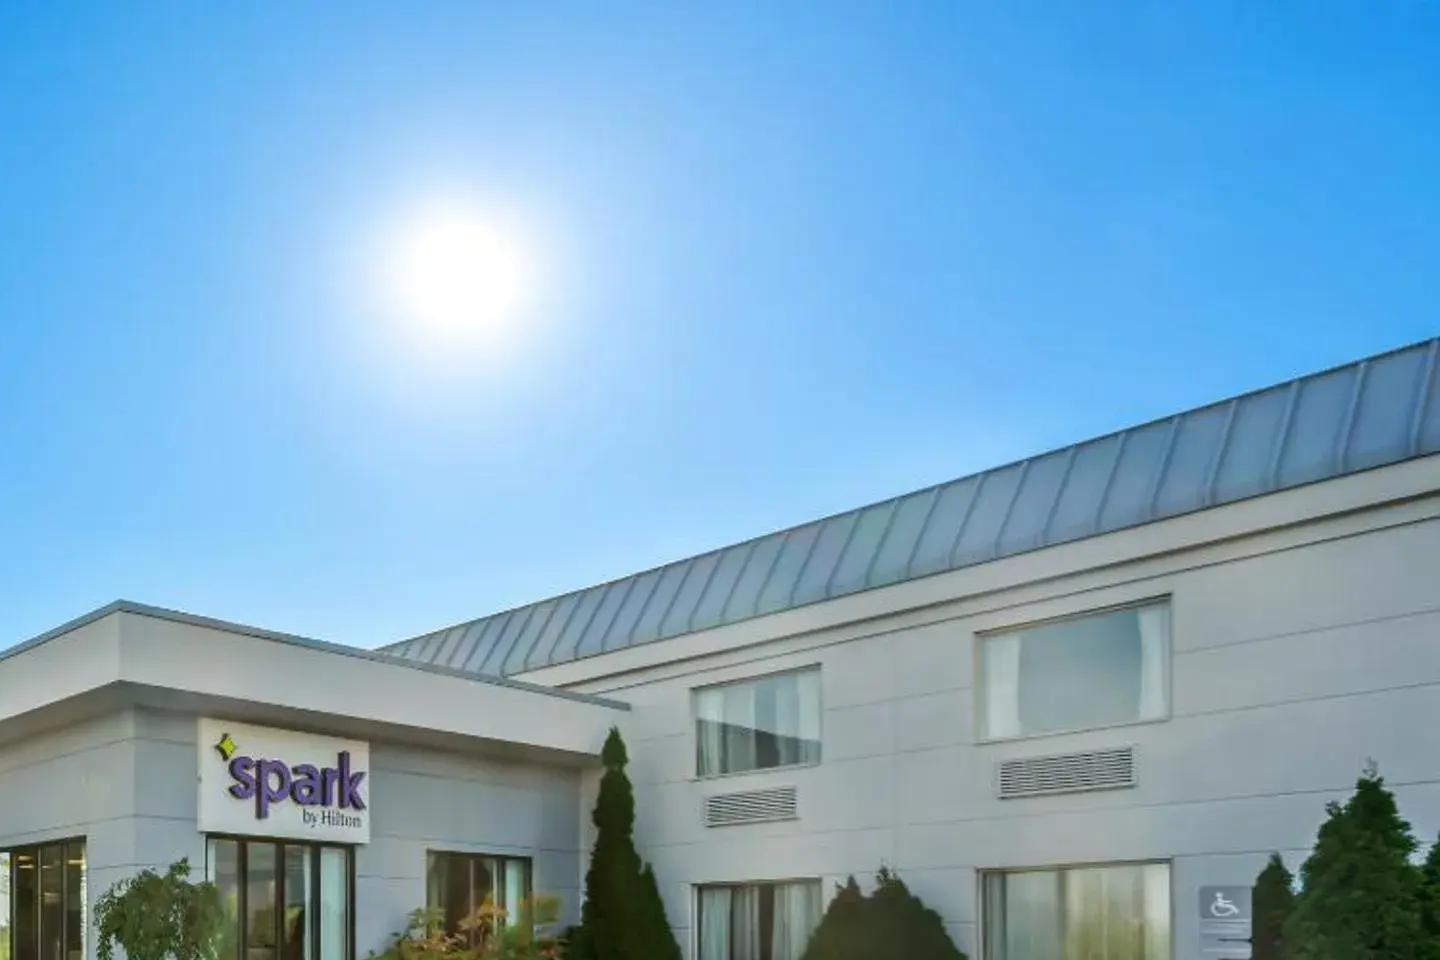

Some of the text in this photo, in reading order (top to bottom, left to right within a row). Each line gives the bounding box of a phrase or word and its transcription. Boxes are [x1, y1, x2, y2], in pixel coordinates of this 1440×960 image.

[228, 751, 366, 819] spark
[303, 808, 362, 828] by Hilton
